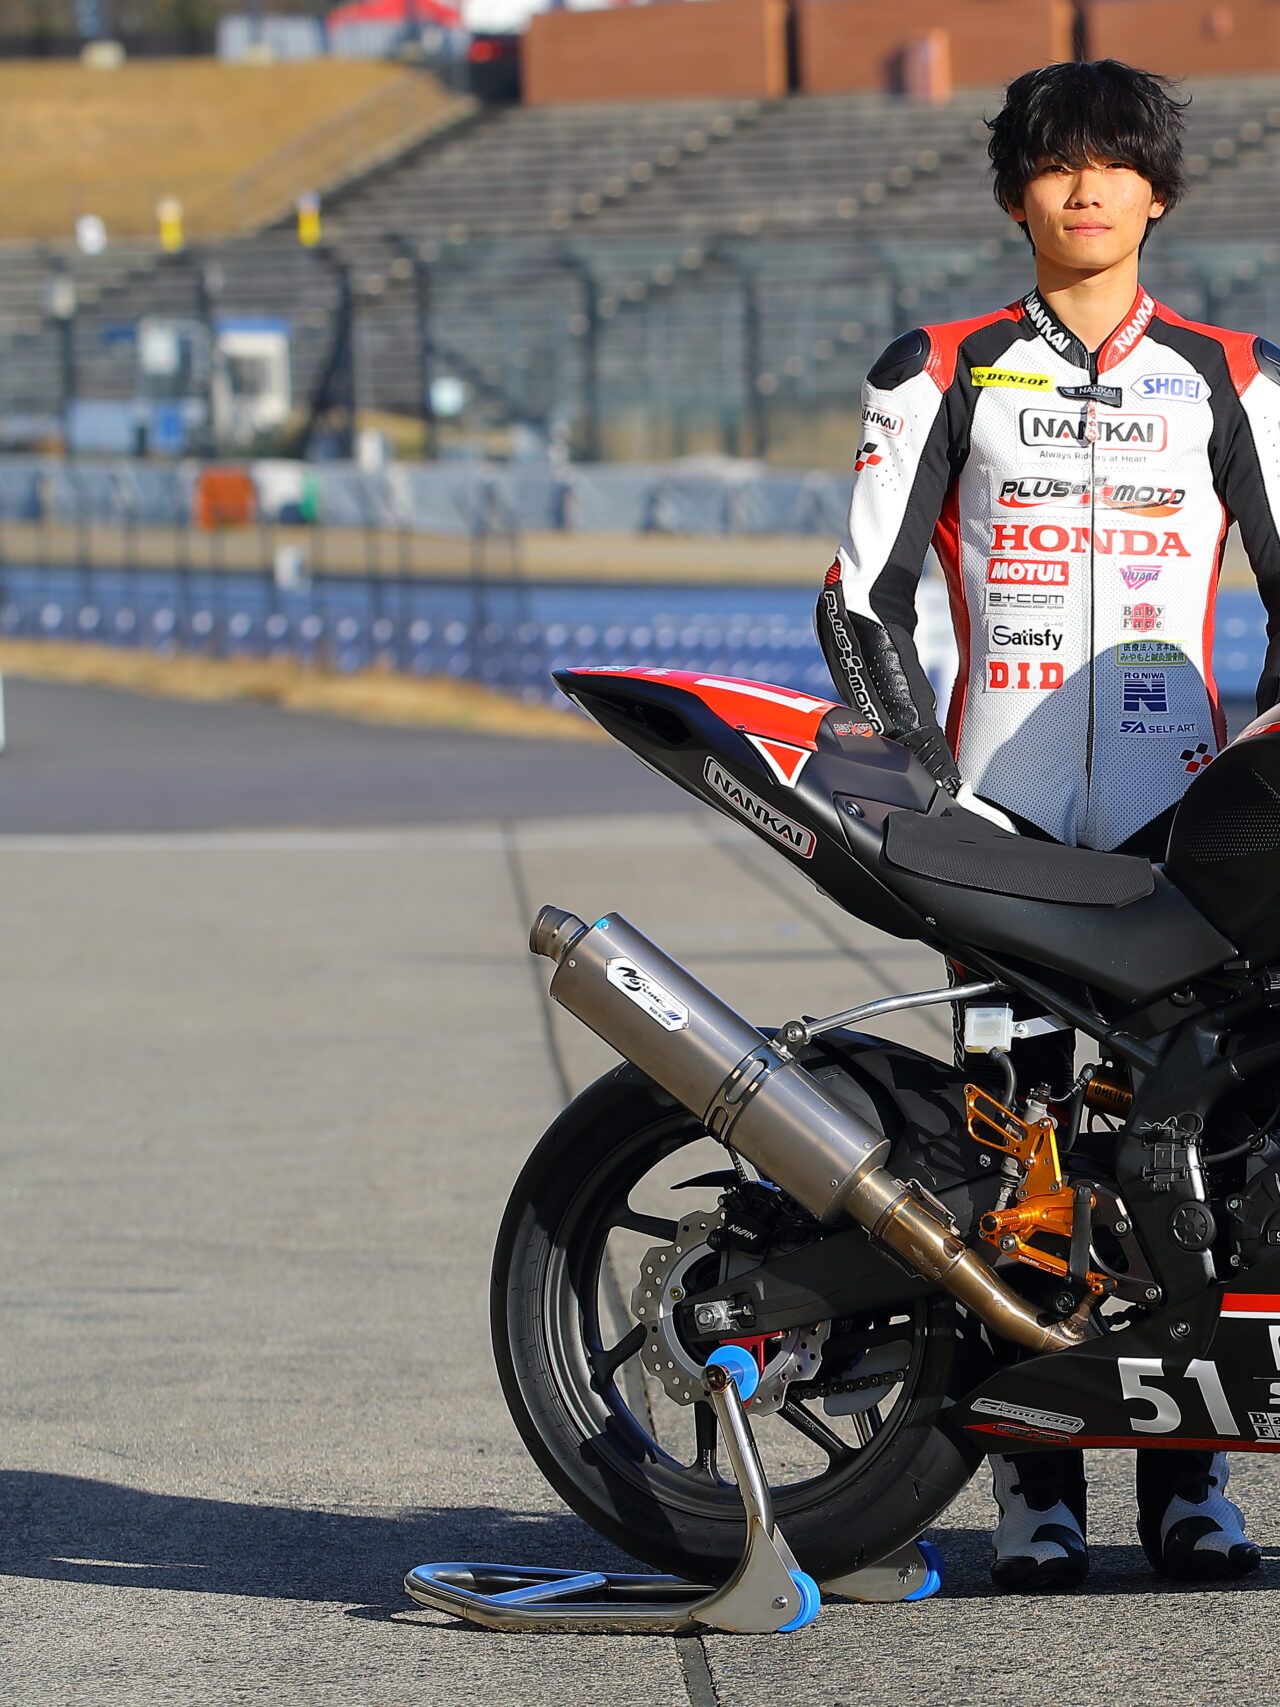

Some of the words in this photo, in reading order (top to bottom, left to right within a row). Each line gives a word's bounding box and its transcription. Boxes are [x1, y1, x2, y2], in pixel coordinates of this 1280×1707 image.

[1024, 293, 1072, 353] NANKAI
[1114, 293, 1155, 353] NANKAI
[986, 372, 1049, 387] DUNLOP
[1078, 386, 1117, 397] NANKAI
[1143, 378, 1201, 399] SHOEI
[1039, 450, 1072, 462] Always
[1109, 454, 1118, 462] at
[1120, 455, 1147, 463] Heart
[1000, 481, 1072, 498] PLUS
[1112, 484, 1186, 506] MOTO
[991, 524, 1192, 557] HONDA
[991, 562, 1066, 583] MOTUL
[1123, 606, 1164, 616] Baby
[1123, 618, 1163, 629] Face
[992, 625, 1063, 650] Satisfy
[825, 590, 854, 652] PLUS
[849, 670, 884, 735] MOTO
[989, 662, 1064, 690] D.I.D
[1148, 725, 1176, 734] SELF
[1177, 723, 1196, 733] ART
[713, 769, 804, 848] NANKAI
[1117, 1357, 1240, 1437] 51
